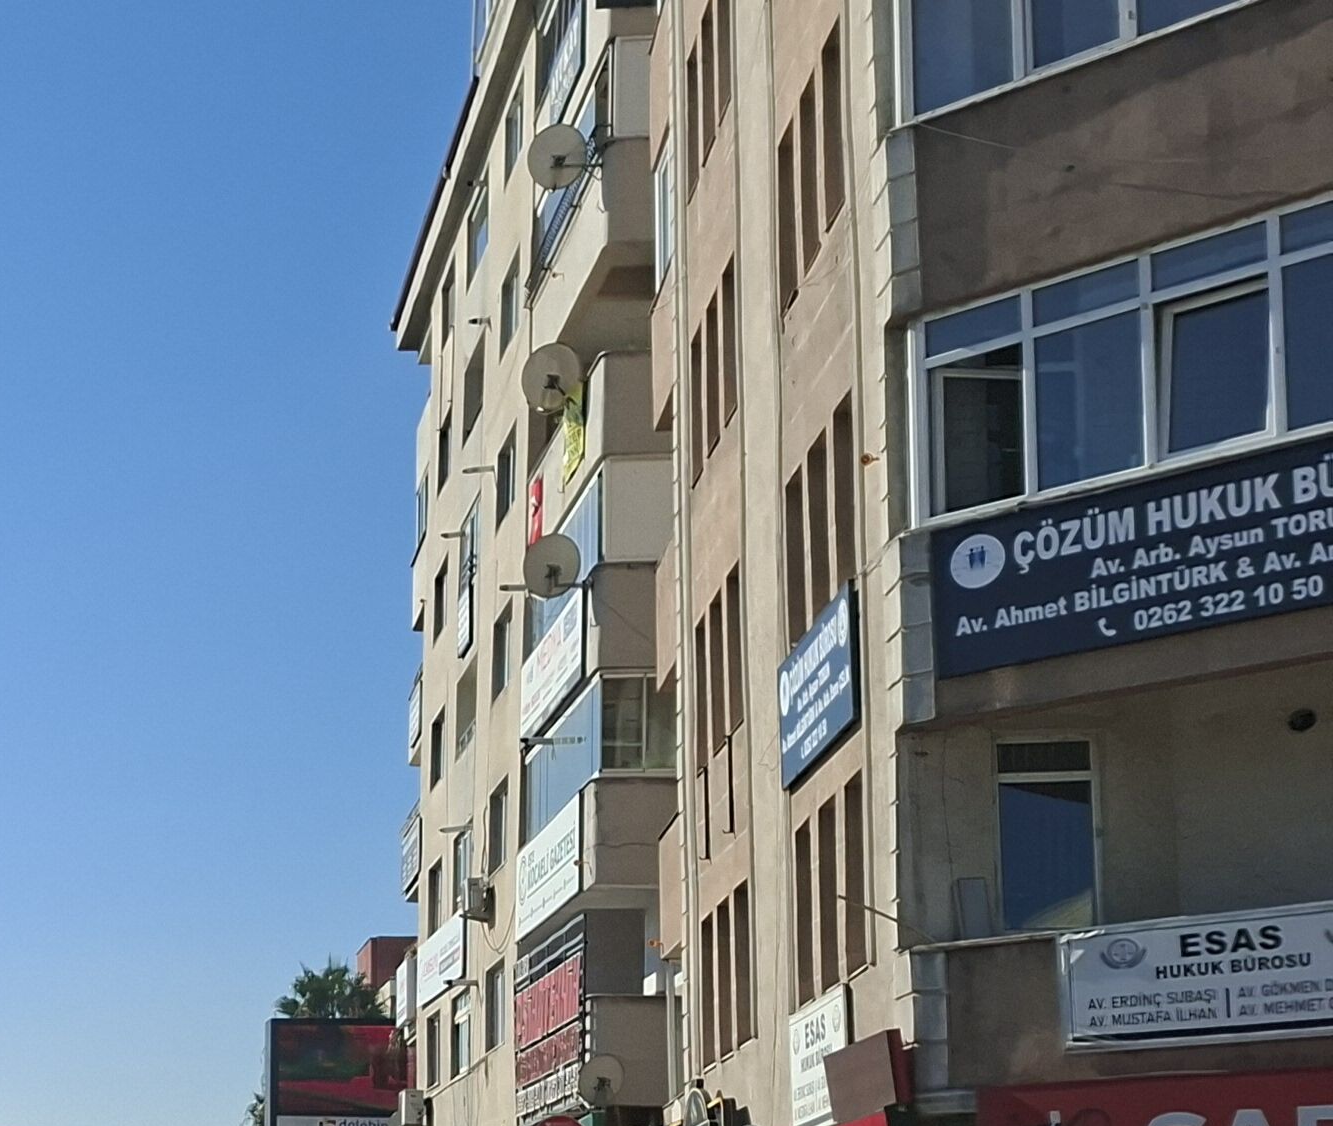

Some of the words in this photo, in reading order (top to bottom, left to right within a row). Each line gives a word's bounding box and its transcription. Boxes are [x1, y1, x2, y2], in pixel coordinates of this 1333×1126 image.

[1013, 507, 1134, 574] ÇÖZÜM
[1147, 473, 1282, 536] HUKUK
[1089, 557, 1124, 579] Av.
[1133, 542, 1180, 570] Arb.
[1190, 527, 1264, 559] Aysun
[956, 616, 987, 637] Av.
[994, 597, 1067, 629] Ahmet
[1074, 560, 1228, 613] BİLGİNTÜRK
[1237, 557, 1255, 579] &
[1263, 551, 1301, 573] Av.
[1134, 601, 1192, 630] 0262
[1199, 590, 1246, 618] 322
[1253, 583, 1283, 608] 10
[1292, 576, 1323, 600] 50
[1180, 925, 1282, 957] ESAS
[1156, 960, 1224, 980] HUKUK
[1231, 952, 1312, 974] BÜROSU
[1088, 998, 1107, 1010] AV.
[1112, 992, 1162, 1009] ERDİNÇ
[1167, 988, 1217, 1004] SUBAŞI
[1261, 980, 1321, 997] GÖKMEN
[1089, 1015, 1107, 1027] AV.
[1112, 1010, 1171, 1025] MUSTAFA
[1176, 1007, 1217, 1022] İLHAN
[1264, 998, 1325, 1015] MEHMET
[804, 1013, 826, 1050] ESAS
